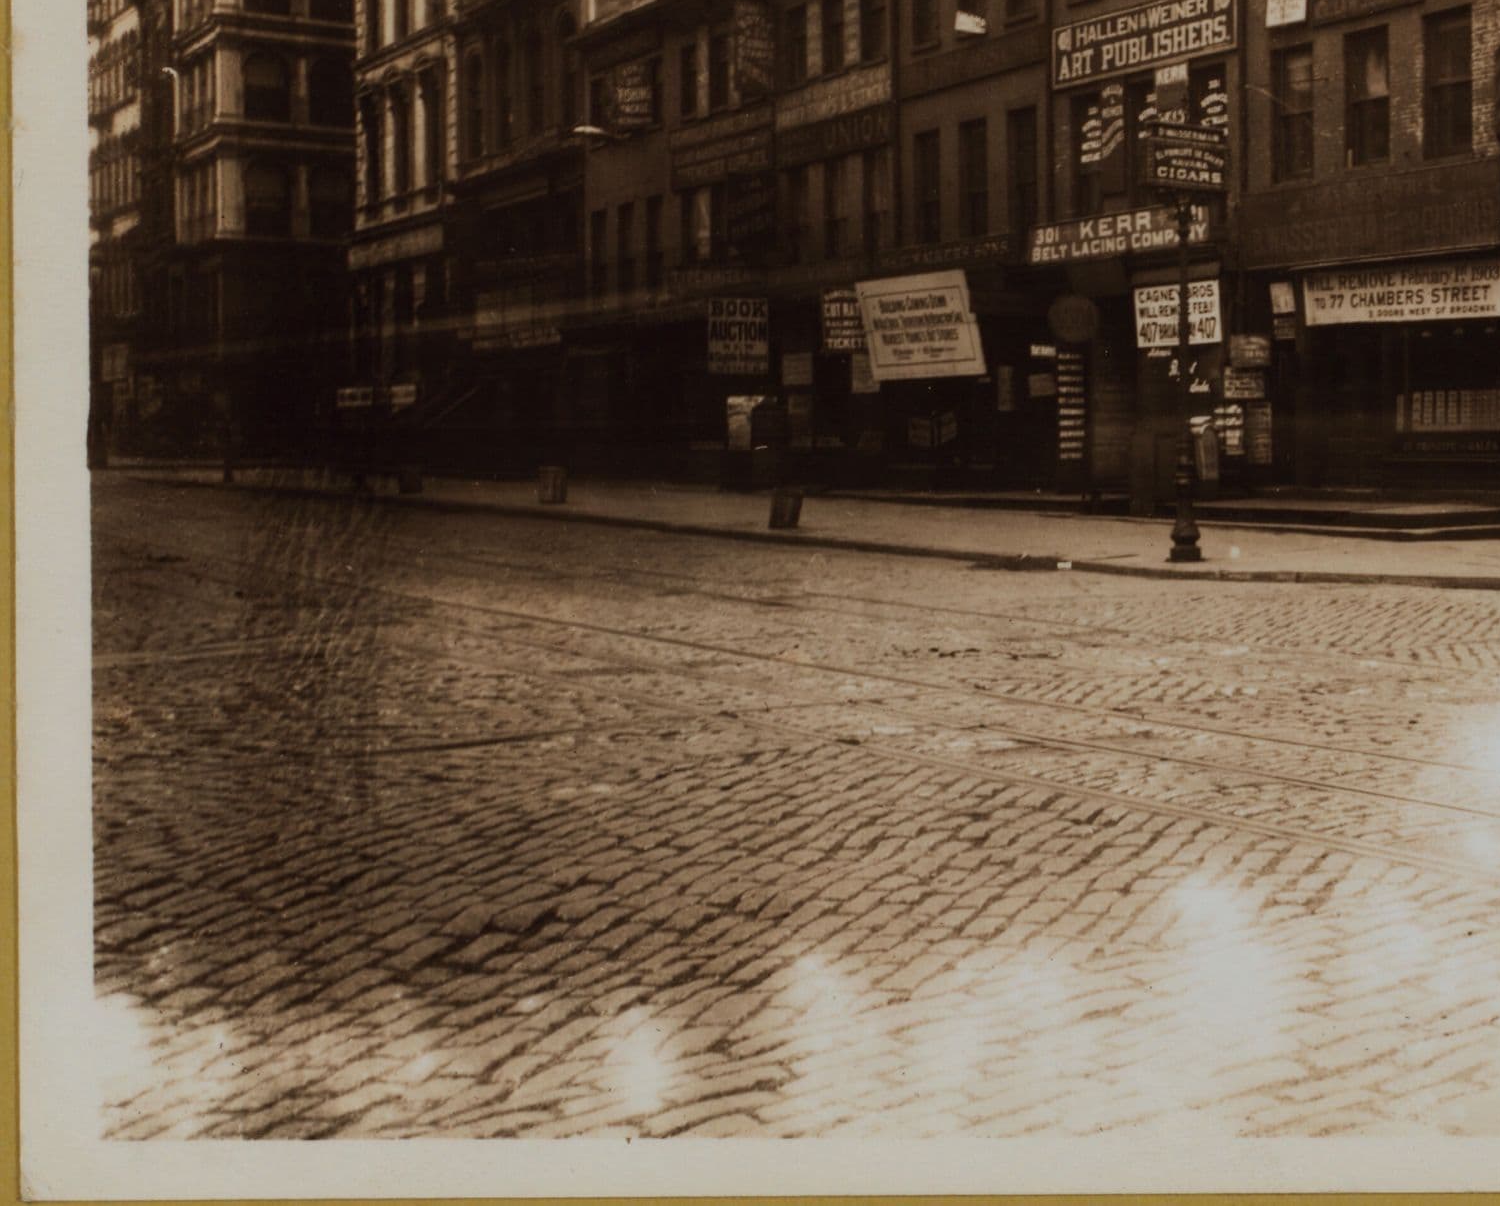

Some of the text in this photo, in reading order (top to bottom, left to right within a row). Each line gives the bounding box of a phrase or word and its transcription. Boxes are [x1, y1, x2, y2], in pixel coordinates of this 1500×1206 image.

[1075, 12, 1139, 48] HALLEN
[1058, 49, 1094, 81] ART
[1157, 166, 1222, 184] CIGARS
[1035, 211, 1151, 244] 301 KERR
[1031, 244, 1068, 262] BELT
[1072, 236, 1127, 257] LACING
[1308, 274, 1335, 292] WILL
[1339, 270, 1396, 291] REMOVE
[1470, 263, 1500, 281] 1903
[711, 299, 766, 317] BOOK
[1329, 295, 1345, 308] 77
[1350, 291, 1425, 309] CHAMBERS
[1431, 285, 1491, 303] STREET
[710, 320, 767, 342] AUCTION
[1197, 316, 1217, 339] 407
